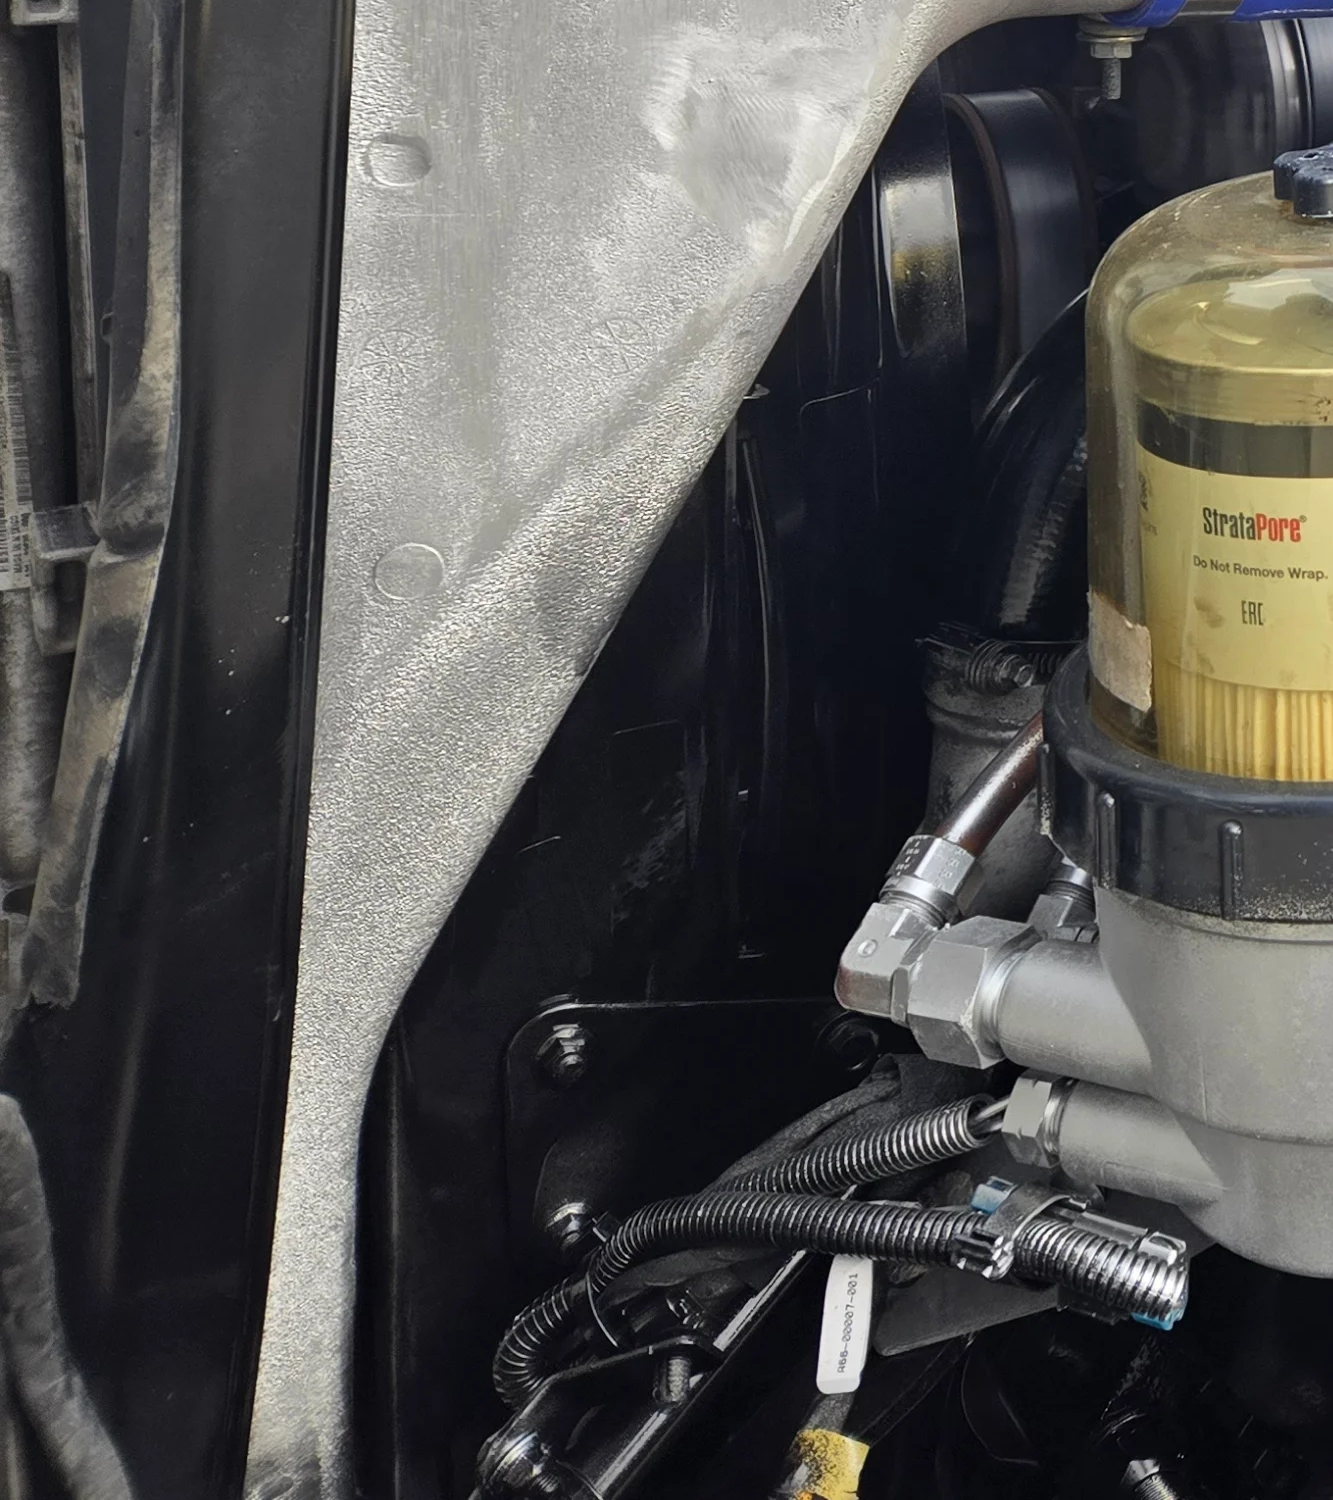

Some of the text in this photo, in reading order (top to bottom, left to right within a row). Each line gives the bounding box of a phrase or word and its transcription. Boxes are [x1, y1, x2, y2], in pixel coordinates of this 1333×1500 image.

[1193, 554, 1329, 582] Do Not Remove Wrap.
[837, 1273, 858, 1373] A66-00007-001
